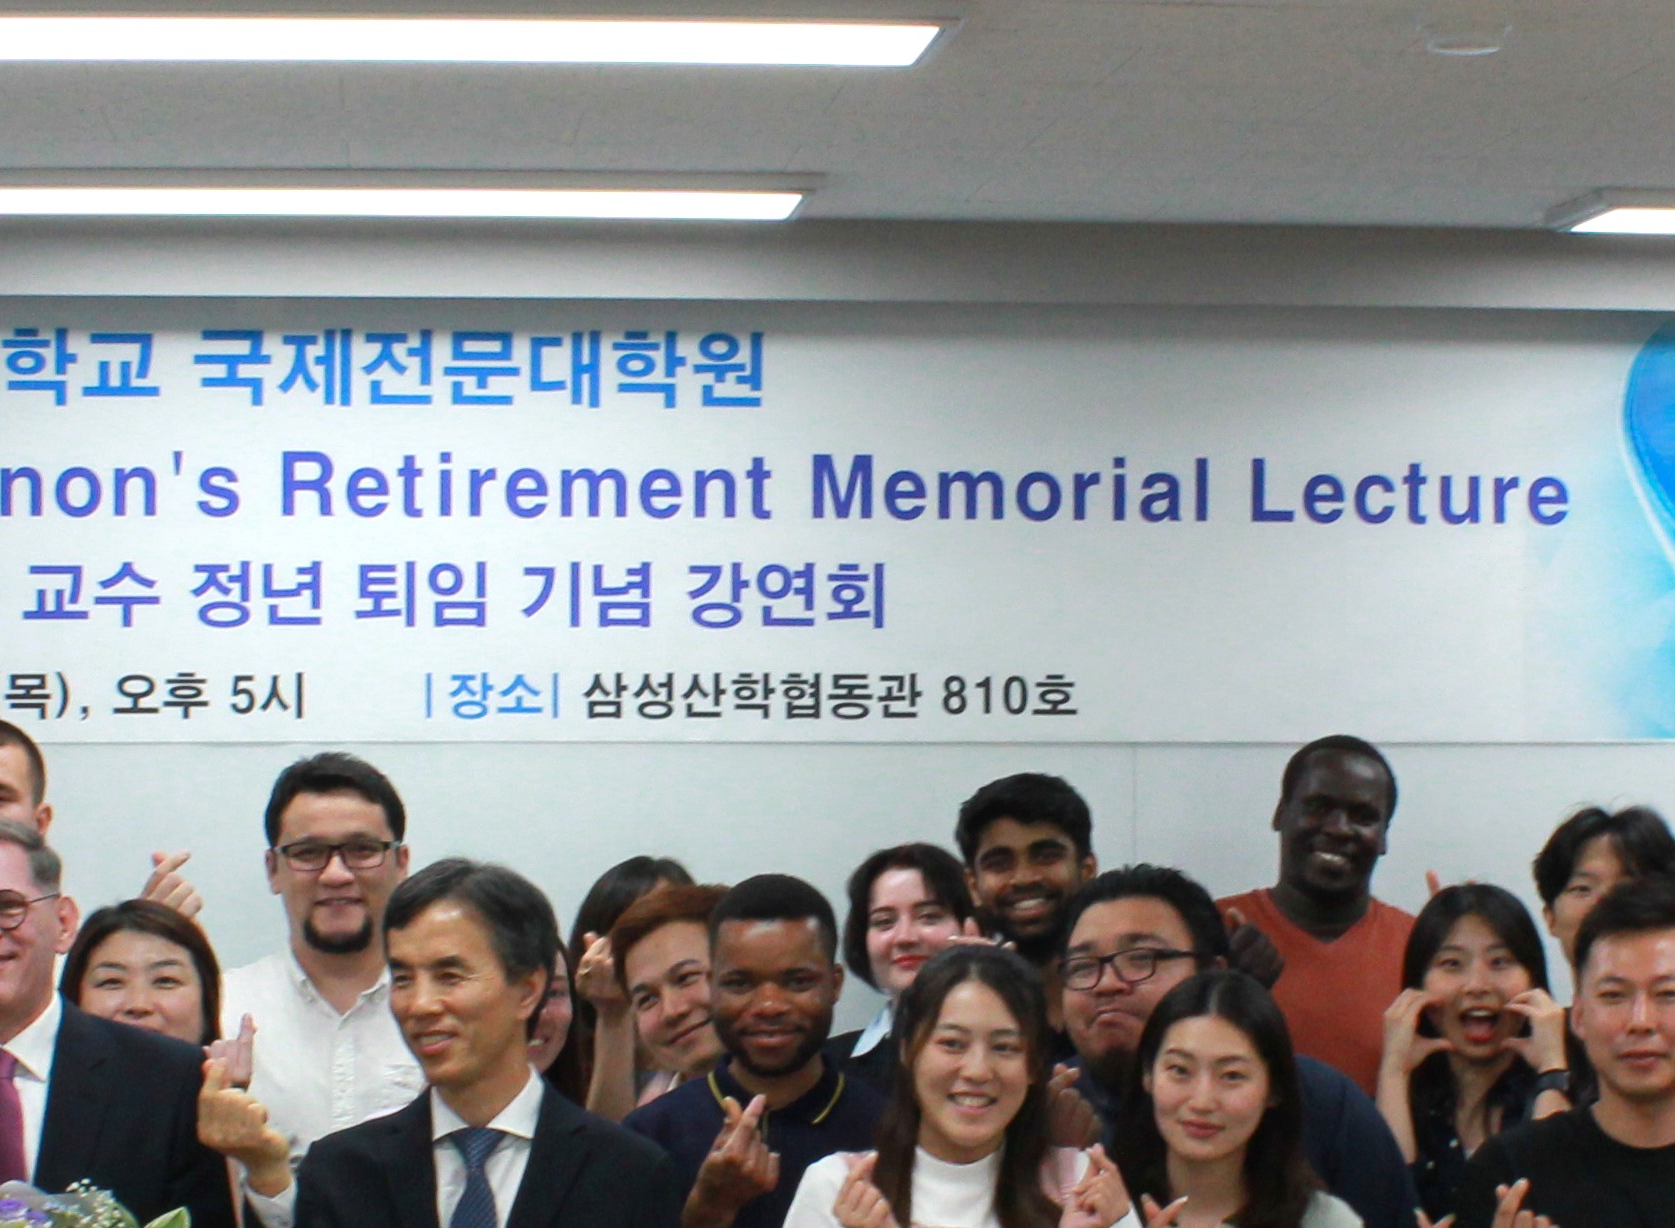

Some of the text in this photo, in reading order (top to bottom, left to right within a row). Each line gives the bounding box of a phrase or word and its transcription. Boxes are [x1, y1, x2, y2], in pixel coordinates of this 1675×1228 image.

[191, 327, 765, 408] 국제전문대학원
[281, 450, 772, 520] Retirement
[812, 453, 1209, 523] Memorial
[1250, 457, 1570, 526] Lecture
[22, 561, 161, 628] 교수
[190, 560, 323, 629] 정년
[354, 560, 487, 628] 퇴임
[521, 561, 652, 628] 기념
[687, 561, 885, 629] 강연회
[112, 672, 210, 720] 오후
[230, 671, 304, 720] 5시
[582, 672, 923, 721] 삼성산학협동관
[942, 673, 1079, 717] 810호
